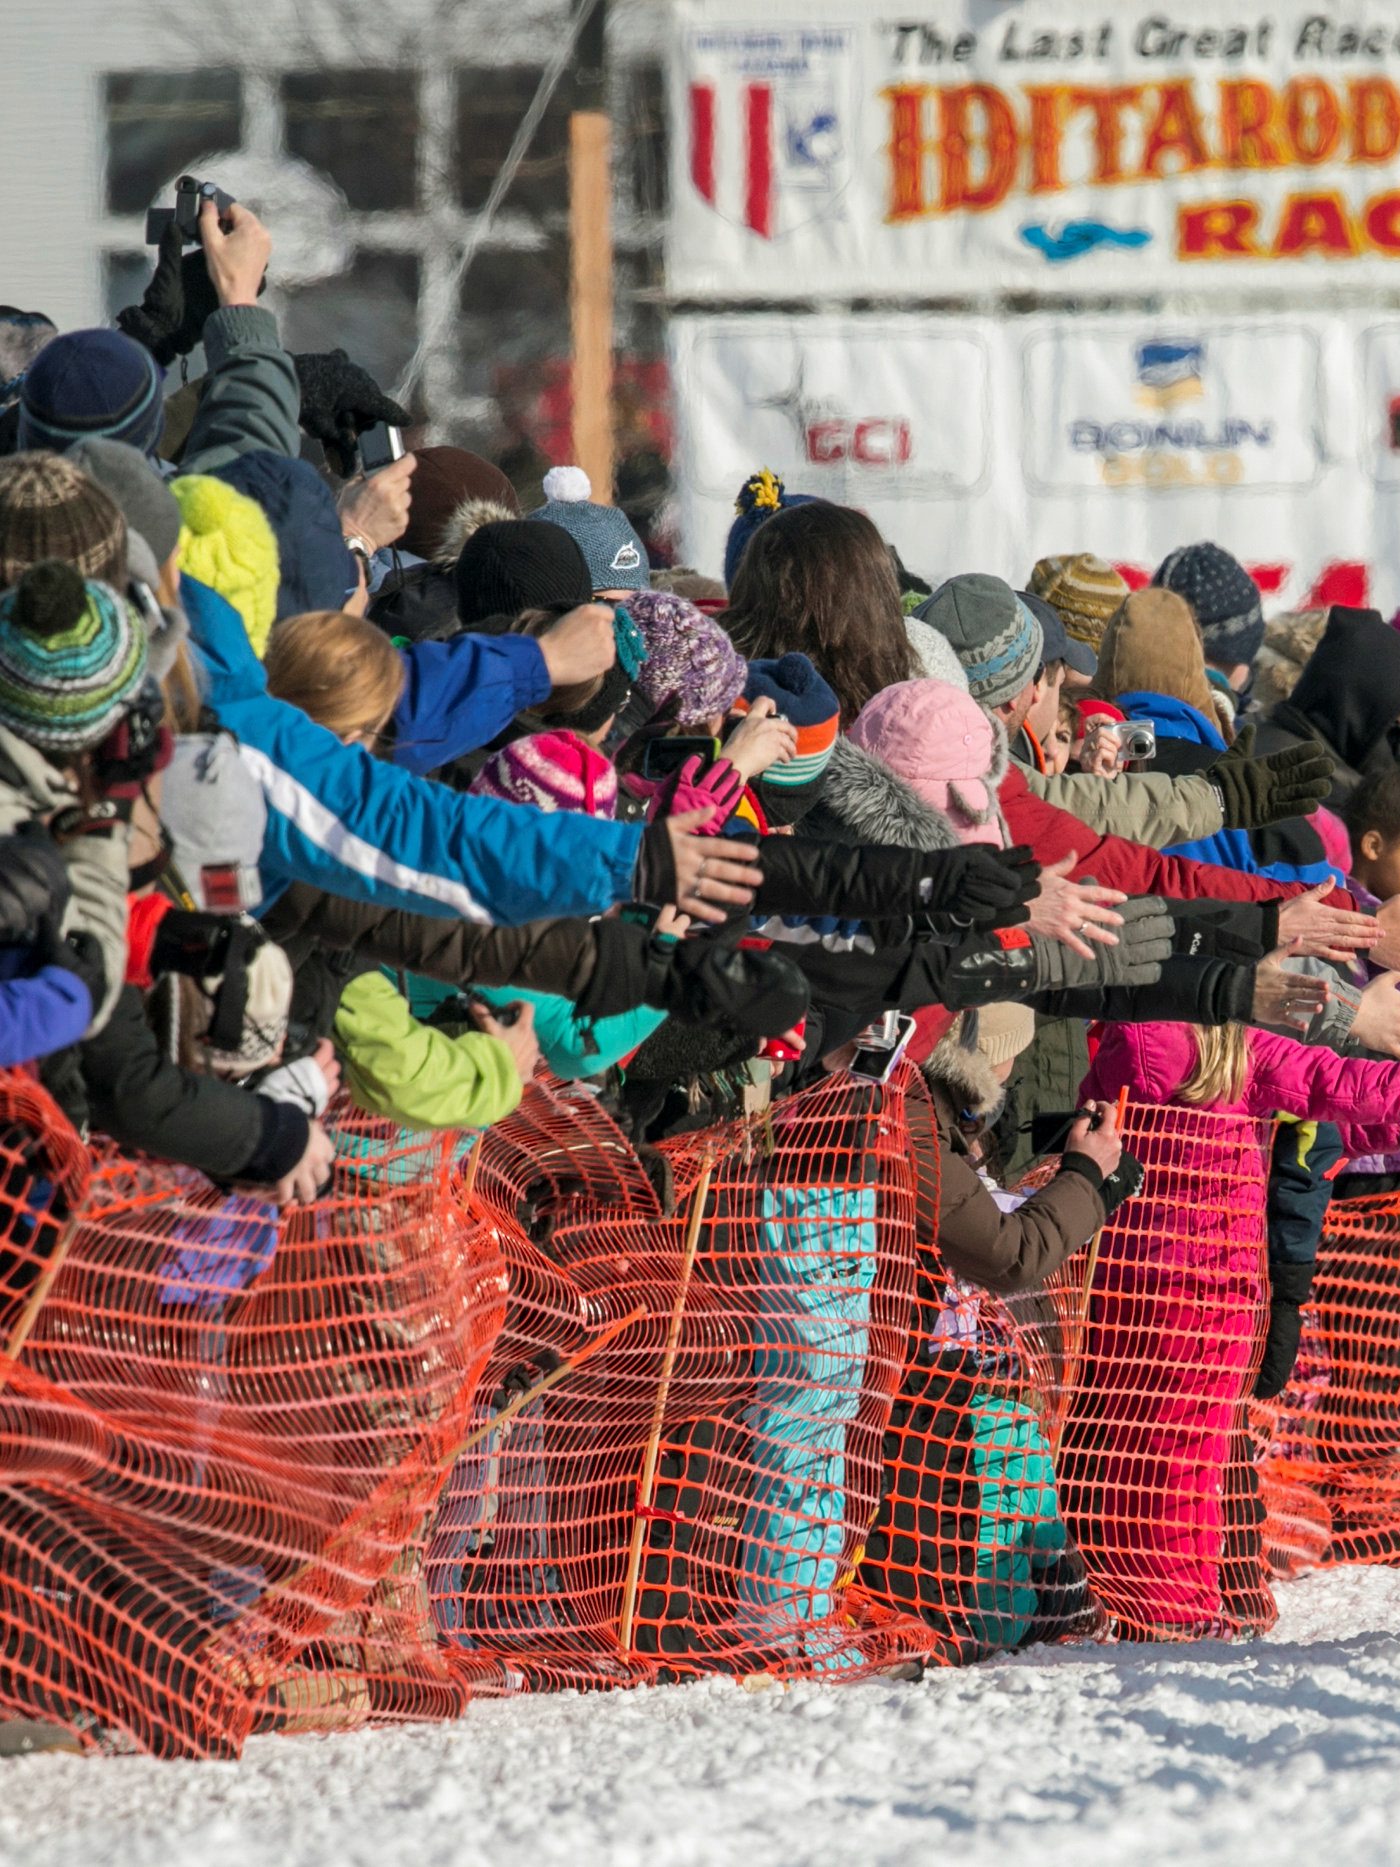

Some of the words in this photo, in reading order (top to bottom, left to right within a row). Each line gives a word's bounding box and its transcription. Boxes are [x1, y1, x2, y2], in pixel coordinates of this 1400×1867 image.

[888, 20, 977, 63] The
[1001, 19, 1112, 62] Last
[1136, 15, 1272, 60] Great
[806, 420, 911, 464] GCI
